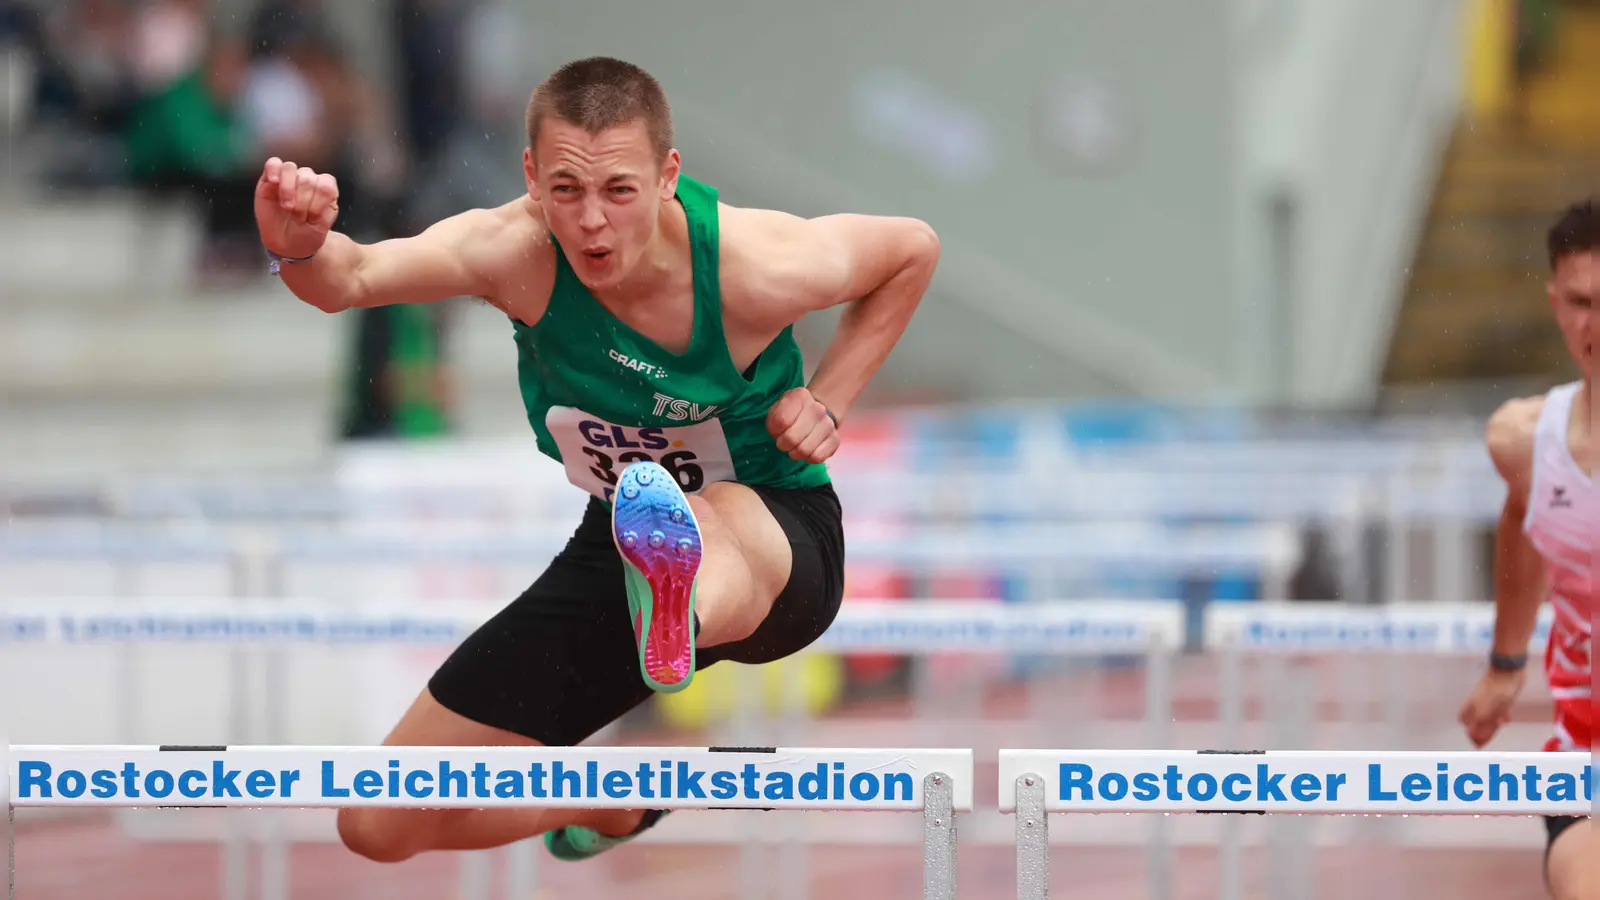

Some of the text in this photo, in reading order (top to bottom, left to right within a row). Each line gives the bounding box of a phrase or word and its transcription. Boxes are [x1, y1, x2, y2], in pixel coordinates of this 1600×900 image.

[608, 348, 656, 375] CRAFT
[652, 391, 718, 421] TSV
[18, 759, 914, 801] Rostocker Leichtathletikstadion
[1059, 762, 1347, 802] Rostocker
